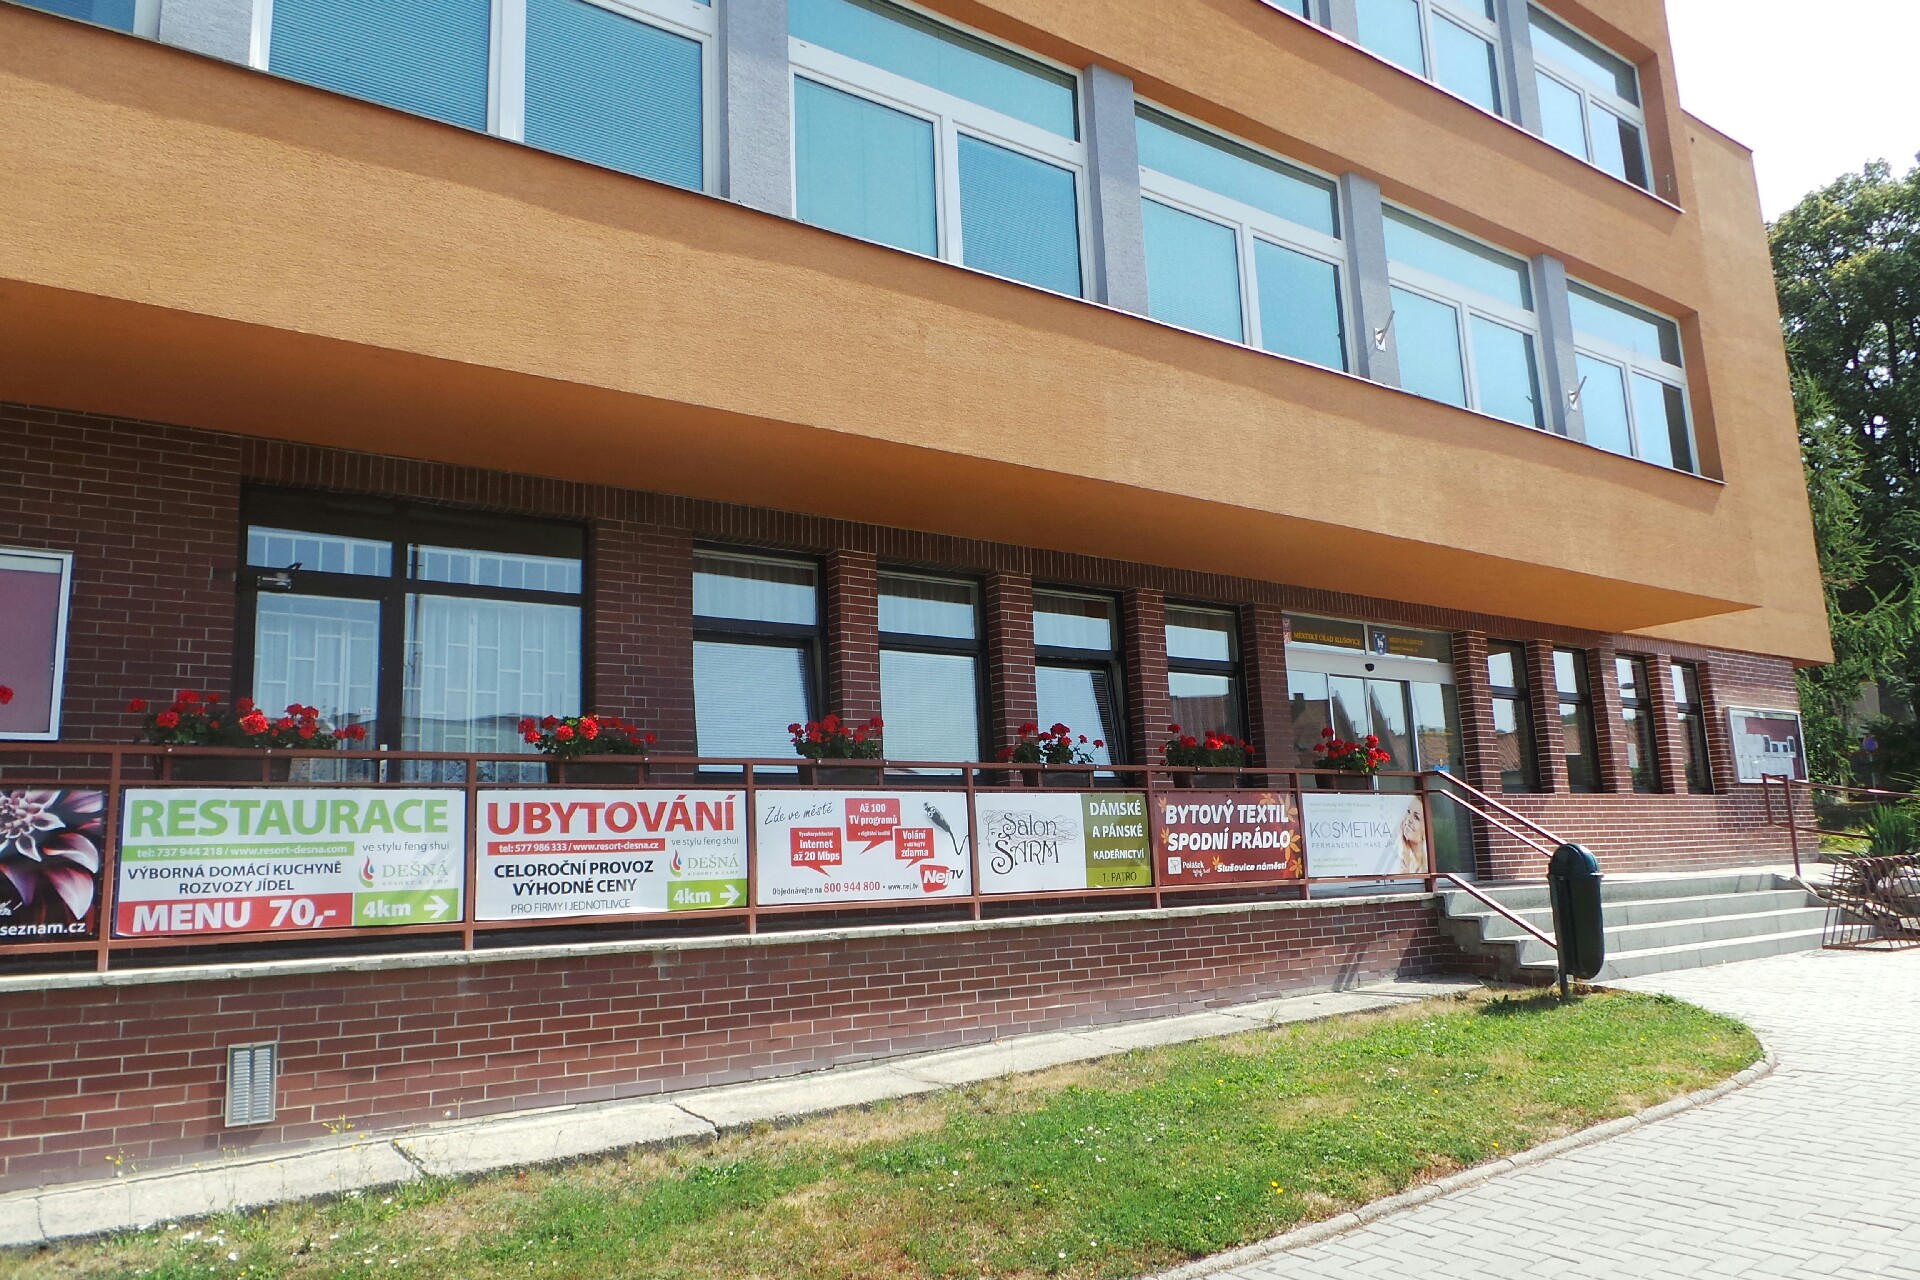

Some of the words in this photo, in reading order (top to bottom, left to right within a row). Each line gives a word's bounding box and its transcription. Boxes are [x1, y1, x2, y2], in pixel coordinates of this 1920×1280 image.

[487, 794, 736, 835] UBYTOVÁNÍ
[764, 806, 785, 825] Zde
[788, 811, 801, 821] ve
[804, 801, 834, 818] městě
[860, 803, 870, 813] Až
[871, 803, 886, 813] 100
[1090, 800, 1141, 816] DÁMSKÉ
[1165, 799, 1235, 825] BYTOVÝ
[1237, 804, 1289, 824] TEXTIL
[129, 798, 449, 838] RESTAURACE
[849, 815, 859, 824] TV
[860, 814, 898, 826] programů
[1002, 812, 1058, 837] Salon
[902, 830, 926, 840] Volání
[1092, 826, 1100, 838] A
[1102, 822, 1143, 838] PÁNSKÉ
[1309, 821, 1393, 839] KOSMETIKA
[362, 843, 374, 851] ve
[377, 841, 401, 853] stylu
[404, 841, 427, 852] feng
[429, 840, 449, 850] shui
[498, 843, 514, 853] tel:
[515, 842, 534, 852] 577
[535, 842, 550, 852] 986
[551, 842, 567, 852] 333
[573, 840, 659, 851] www.resort-desna.cz
[683, 837, 701, 847] stylu
[703, 836, 720, 846] feng
[723, 836, 739, 844] shui
[1167, 826, 1230, 851] SPODNÍ
[1231, 826, 1291, 850] PRÁDLO
[137, 848, 155, 858] tel:
[157, 848, 176, 857] 737
[179, 847, 200, 857] 944
[202, 847, 223, 856] 218
[230, 844, 348, 855] www.resort-desna.com
[793, 851, 803, 861] až
[804, 851, 816, 861] 20
[817, 851, 840, 863] Mbps
[901, 849, 929, 857] zdarma
[1093, 847, 1145, 860] KADEŘNICTVÍ
[382, 860, 449, 878] DEŠNÁ
[494, 859, 588, 878] CELOROČNÍ
[590, 860, 654, 876] PROVOZ
[688, 853, 739, 869] DEŠNÁ
[1217, 862, 1255, 873] Slušovice
[1256, 861, 1288, 871] náměstí
[128, 864, 205, 880] VÝBORNÁ
[209, 863, 271, 877] DOMÁCÍ
[274, 861, 343, 876] KUCHYNĚ
[1102, 873, 1110, 883] 1.
[1111, 871, 1137, 882] PATRO
[179, 880, 254, 894] ROZVOZY
[255, 878, 295, 892] JÍDEL
[513, 878, 594, 896] VÝHODNÉ
[596, 879, 638, 894] CENY
[772, 887, 814, 896] Objednávejte
[823, 882, 841, 893] 800
[844, 882, 861, 892] 944
[863, 881, 880, 891] 800
[887, 883, 919, 891] www.nej.tv
[673, 888, 711, 904] 4km
[362, 899, 411, 918] 4km
[511, 903, 532, 914] PRO
[534, 902, 564, 913] FIRMY
[569, 899, 631, 912] JEDNOTLIVCE
[132, 900, 251, 933] MENU
[269, 898, 337, 929] 70,-
